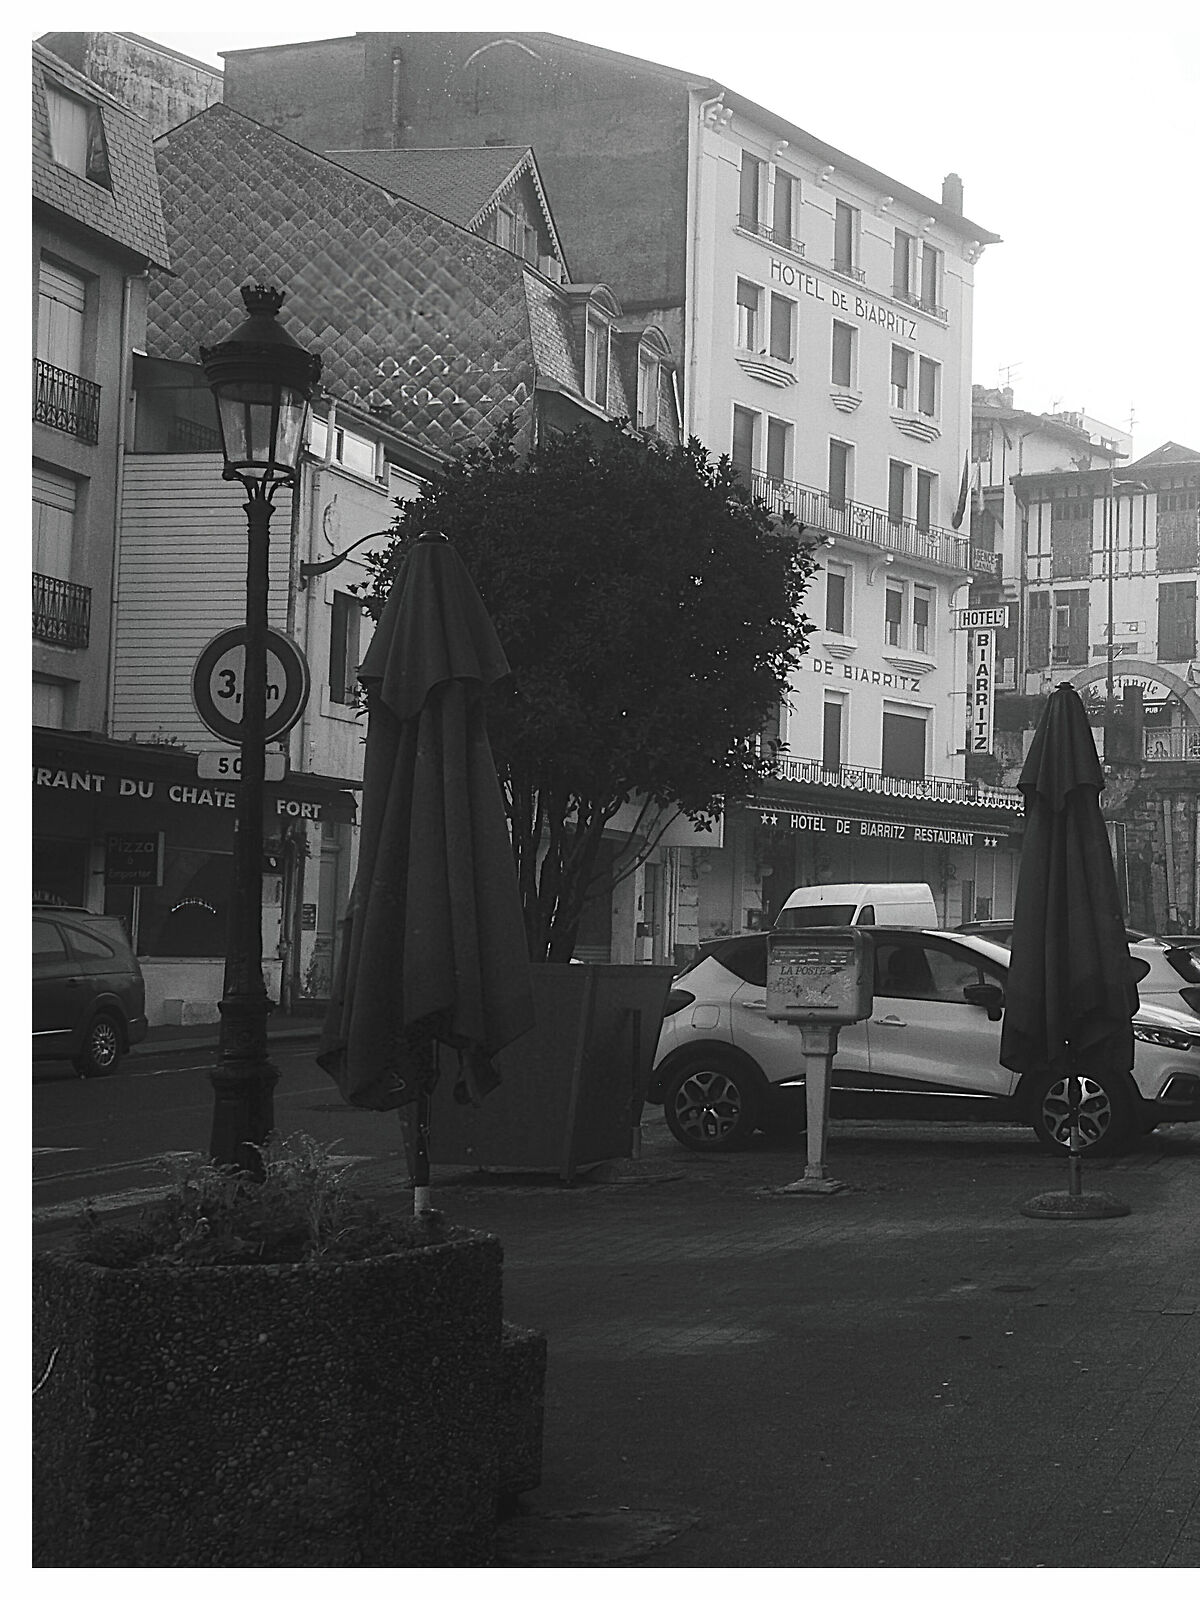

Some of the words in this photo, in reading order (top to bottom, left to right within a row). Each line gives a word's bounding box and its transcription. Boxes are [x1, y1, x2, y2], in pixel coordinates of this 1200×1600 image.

[770, 257, 824, 301] HOTEL
[832, 289, 848, 311] DE
[963, 610, 1000, 626] HOTEL
[217, 669, 279, 704] 3,m
[813, 659, 833, 675] DE
[843, 664, 920, 692] BIARRITZ
[975, 633, 990, 751] BIARRITZ
[33, 767, 105, 792] RANT
[119, 778, 154, 798] DU
[275, 799, 322, 819] FORT
[108, 836, 155, 853] Pizza
[790, 815, 826, 832] HOTEL
[836, 820, 851, 834] DE
[860, 821, 905, 840] BIARRITZ
[914, 828, 973, 846] RESTAURANT
[780, 965, 794, 976] LA
[795, 965, 826, 976] POSTE
